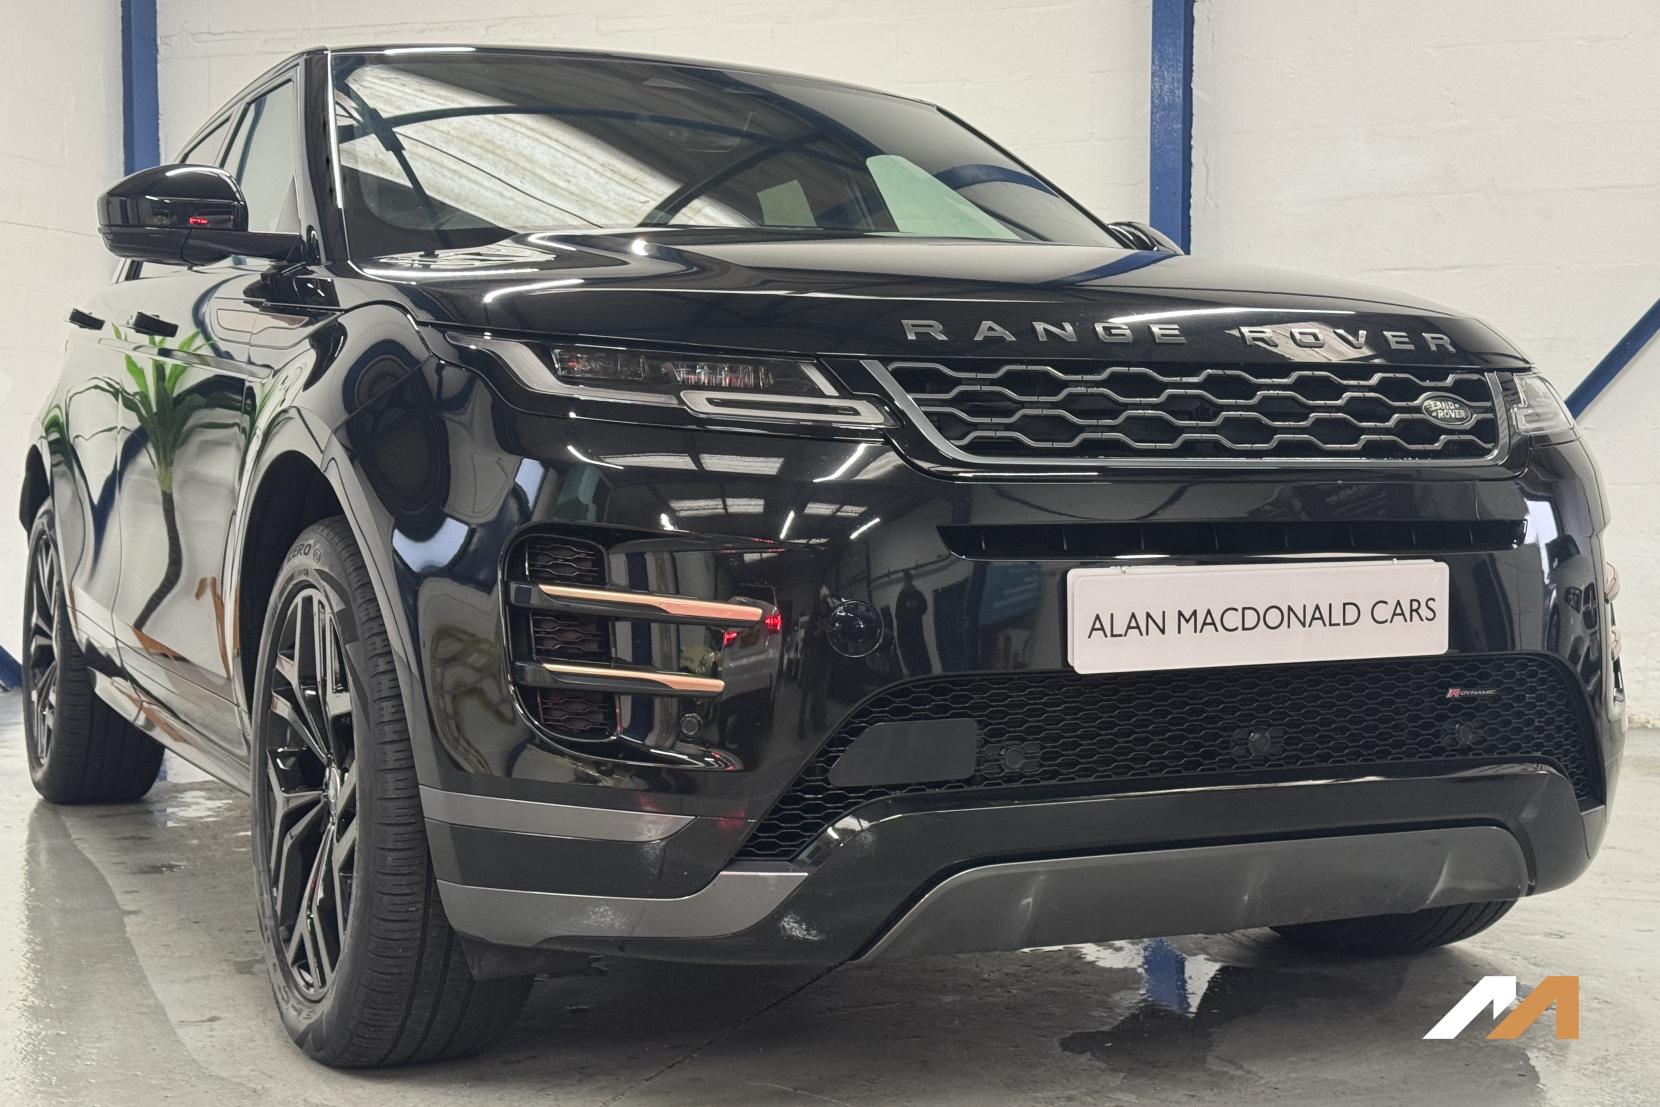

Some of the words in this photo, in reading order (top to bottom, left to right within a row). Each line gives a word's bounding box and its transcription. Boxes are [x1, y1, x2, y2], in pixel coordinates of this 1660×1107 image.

[902, 319, 1186, 344] RANGE
[1241, 325, 1456, 352] ROVER
[1430, 400, 1455, 410] LAND
[1437, 409, 1466, 419] ROVER
[1088, 611, 1166, 639] ALAN
[1177, 602, 1361, 635] MACDONALD
[1370, 597, 1437, 624] CARS
